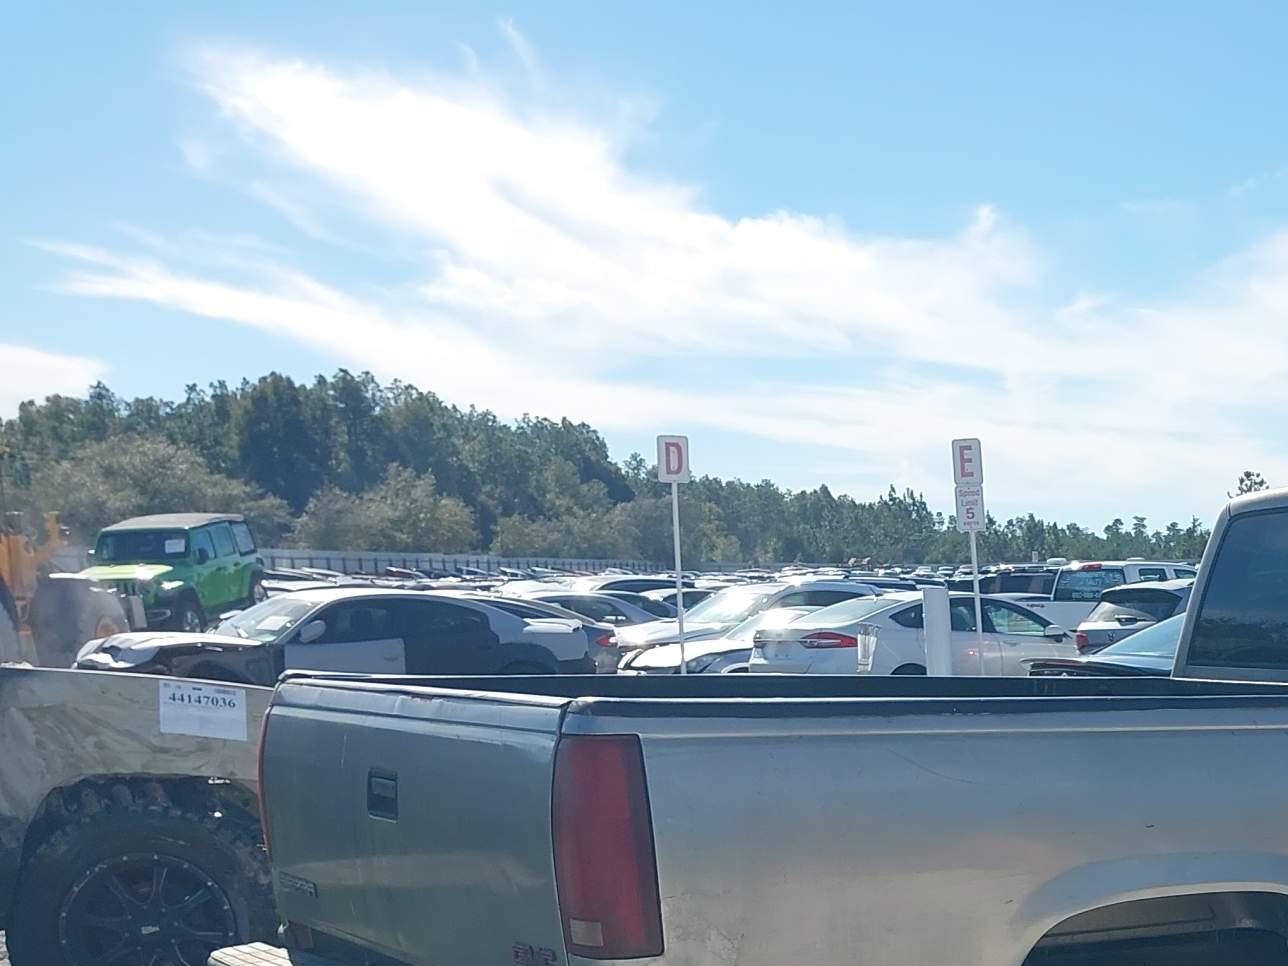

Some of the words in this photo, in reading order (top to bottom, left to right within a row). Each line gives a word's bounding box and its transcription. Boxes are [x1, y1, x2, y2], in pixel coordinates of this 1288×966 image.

[664, 442, 683, 475] D
[959, 445, 974, 478] E
[966, 507, 975, 520] 5
[168, 692, 236, 709] 44147036
